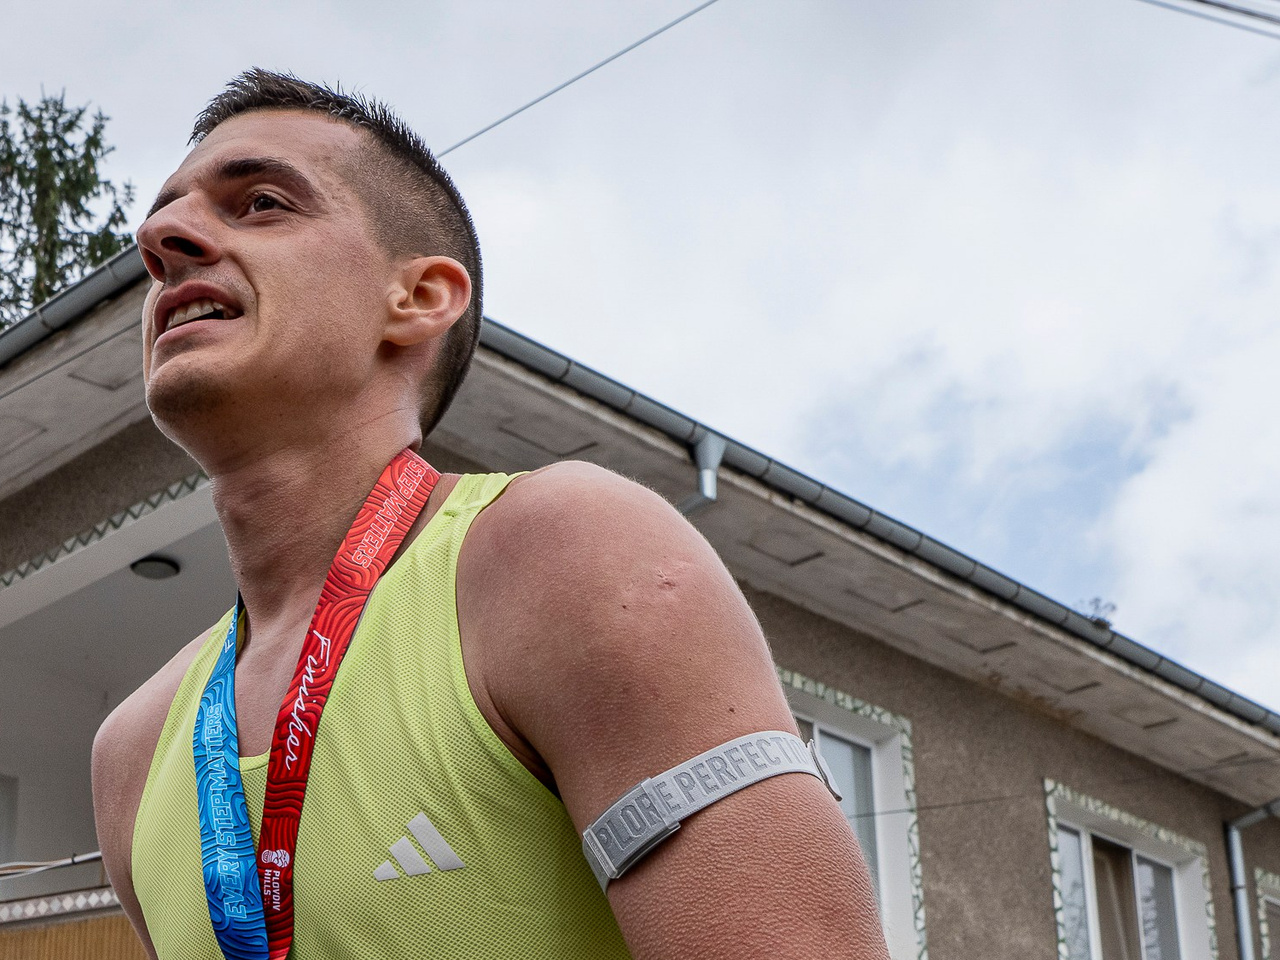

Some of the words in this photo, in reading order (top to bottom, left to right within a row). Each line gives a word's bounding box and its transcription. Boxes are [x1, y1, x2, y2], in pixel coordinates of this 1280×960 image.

[398, 460, 427, 499] STEP
[352, 491, 407, 568] MATTERS
[285, 630, 331, 771] Finisher
[206, 702, 228, 792] MATTERS
[210, 793, 236, 847] STEP
[217, 850, 248, 919] EVERY
[264, 869, 272, 896] HILLS
[272, 870, 281, 911] PLOVDIV
